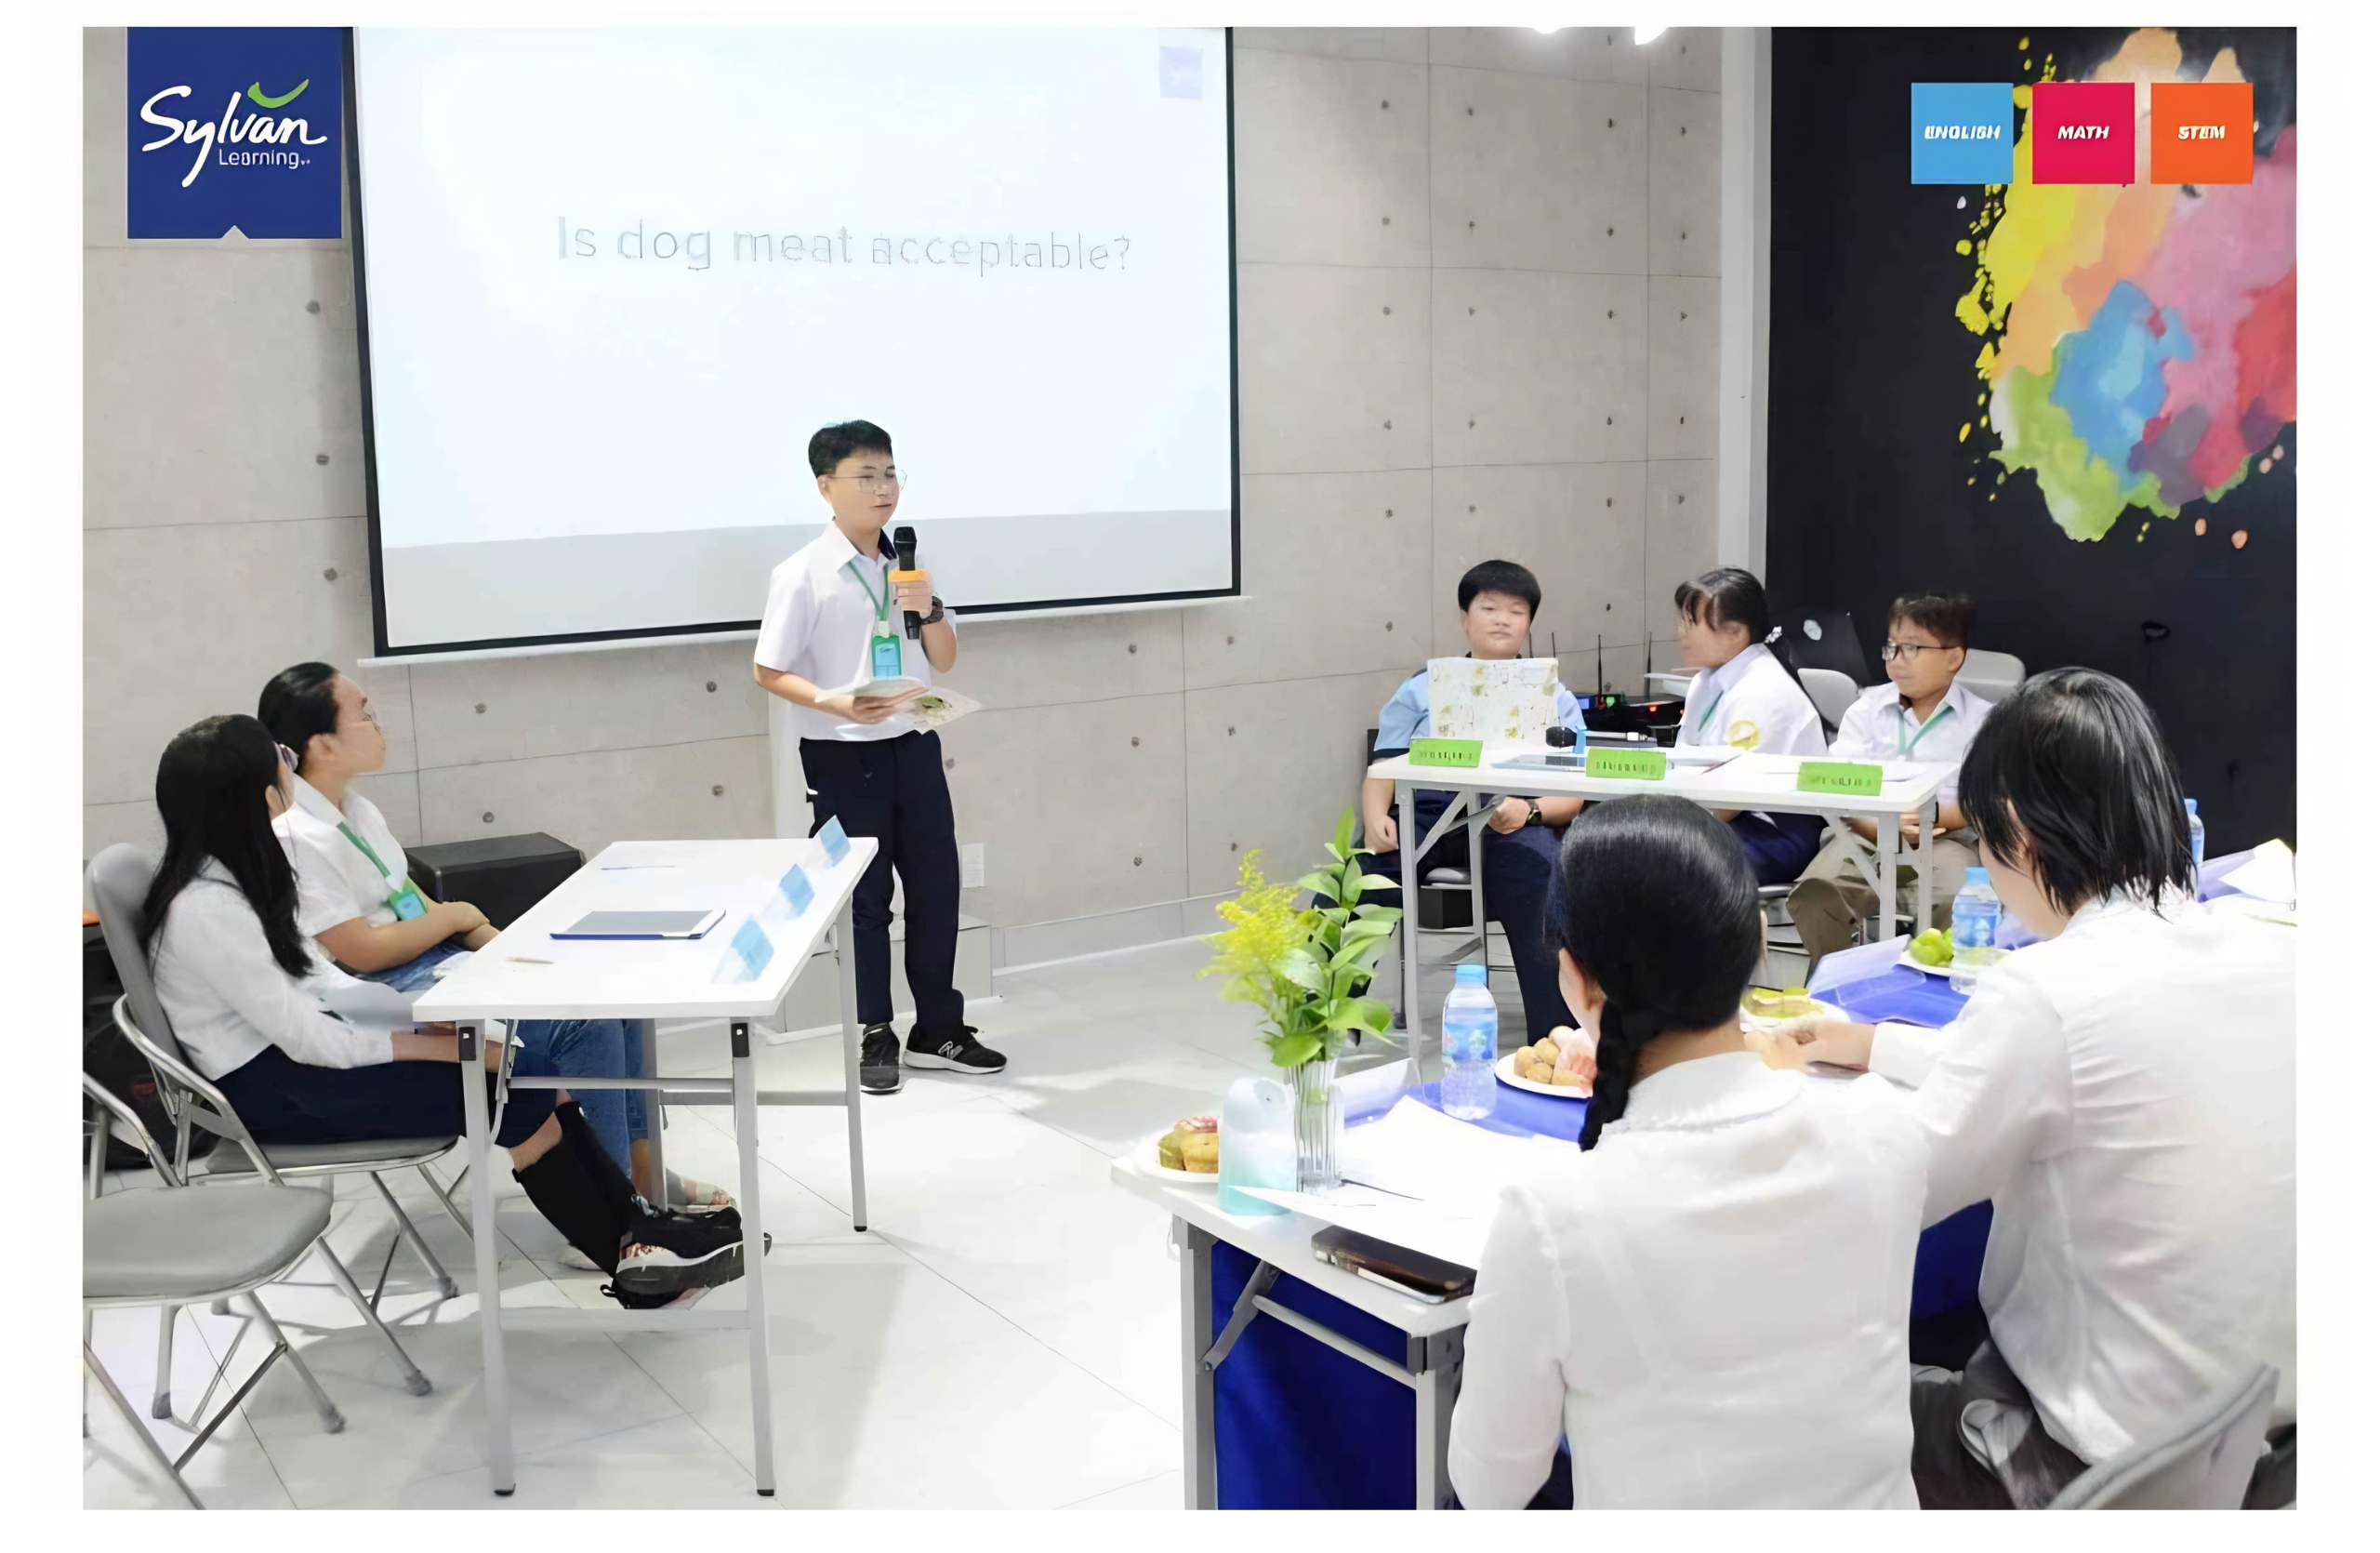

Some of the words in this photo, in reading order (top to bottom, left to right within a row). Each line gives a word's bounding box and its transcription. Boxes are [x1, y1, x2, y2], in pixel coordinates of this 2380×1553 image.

[558, 216, 597, 259] Is
[617, 218, 711, 272] dog
[734, 226, 853, 264] meat
[871, 232, 1131, 278] acceptable?
